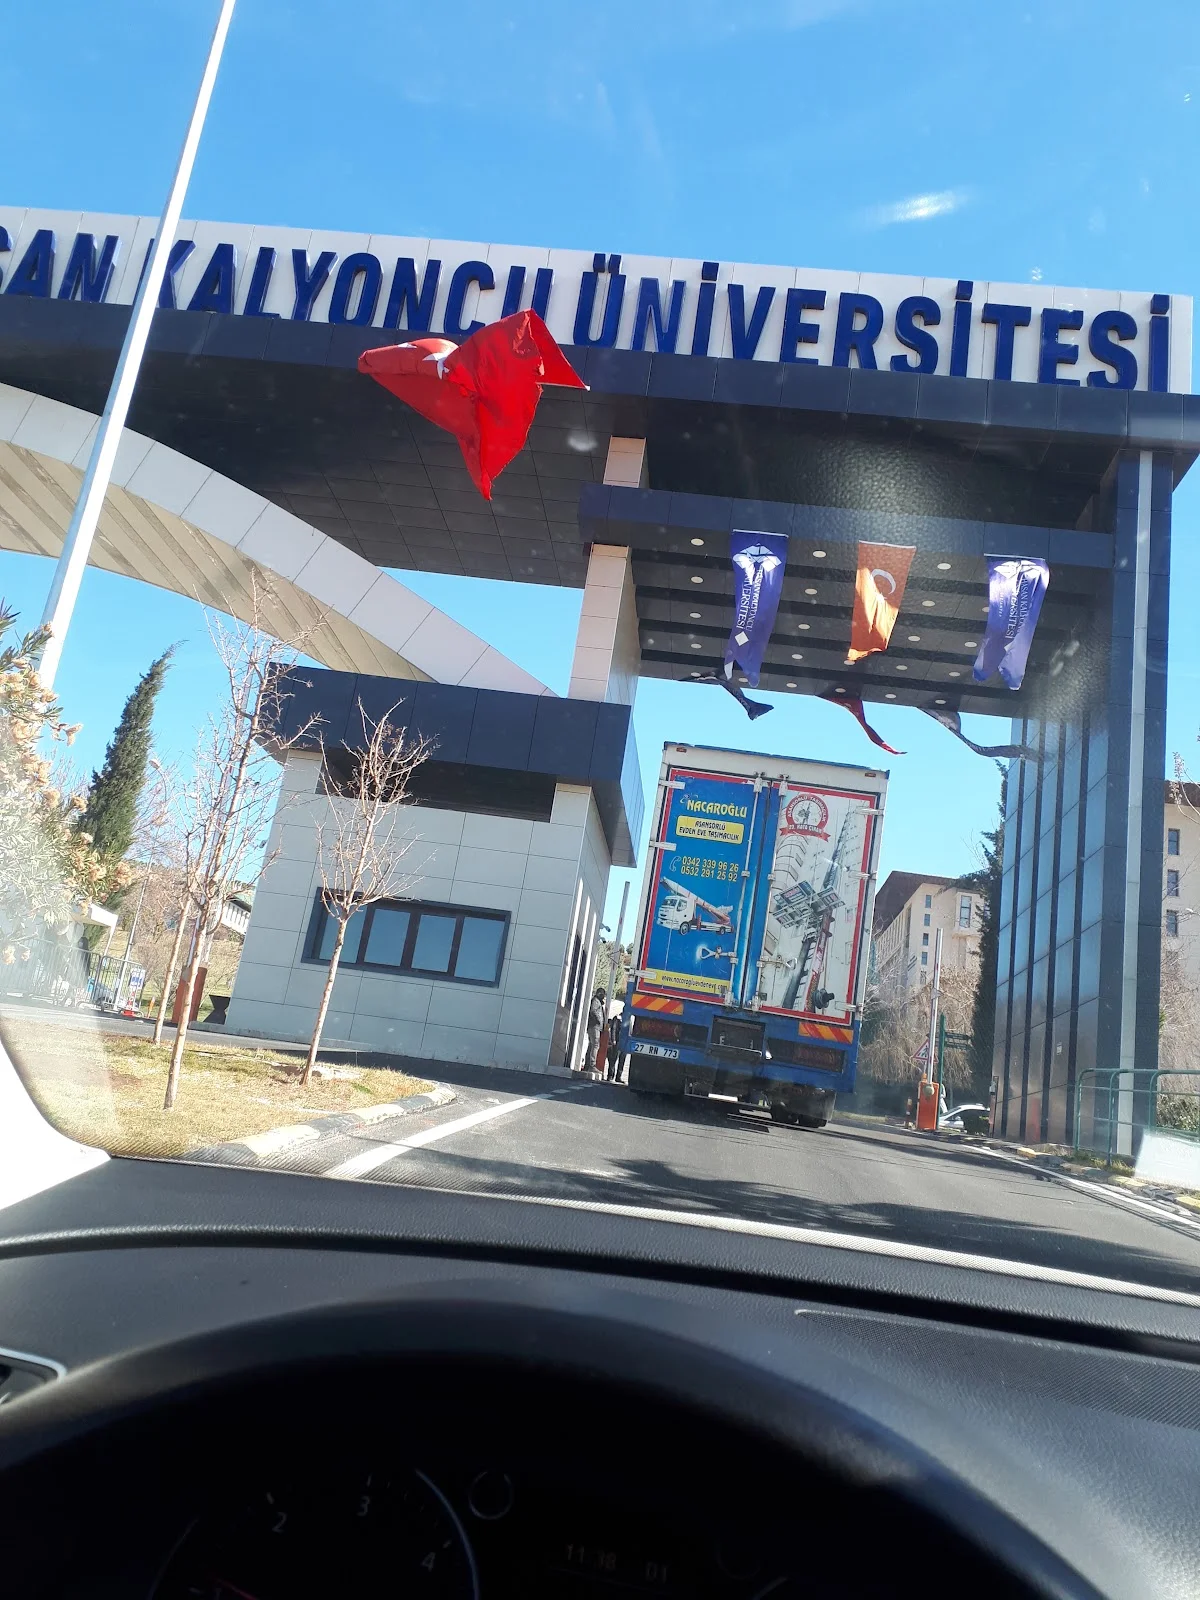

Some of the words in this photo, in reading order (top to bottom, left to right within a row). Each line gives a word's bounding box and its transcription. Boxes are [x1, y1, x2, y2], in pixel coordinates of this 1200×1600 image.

[572, 253, 1171, 393] ÜNİVERSİTESİ
[687, 799, 748, 818] NACAROĞLU
[679, 826, 696, 835] EVDEN
[697, 829, 707, 837] EVE
[708, 830, 740, 841] TAŞIMACILIK
[680, 865, 699, 877] 0532
[701, 868, 714, 878] 291
[717, 870, 726, 880] 25
[728, 872, 738, 882] 92
[682, 856, 701, 867] 0342
[702, 858, 716, 869] 339
[718, 861, 728, 871] 96
[729, 863, 739, 873] 26
[634, 1044, 645, 1052] 27
[663, 1048, 678, 1058] 773
[271, 1510, 288, 1535] 2
[420, 1551, 436, 1572] 4
